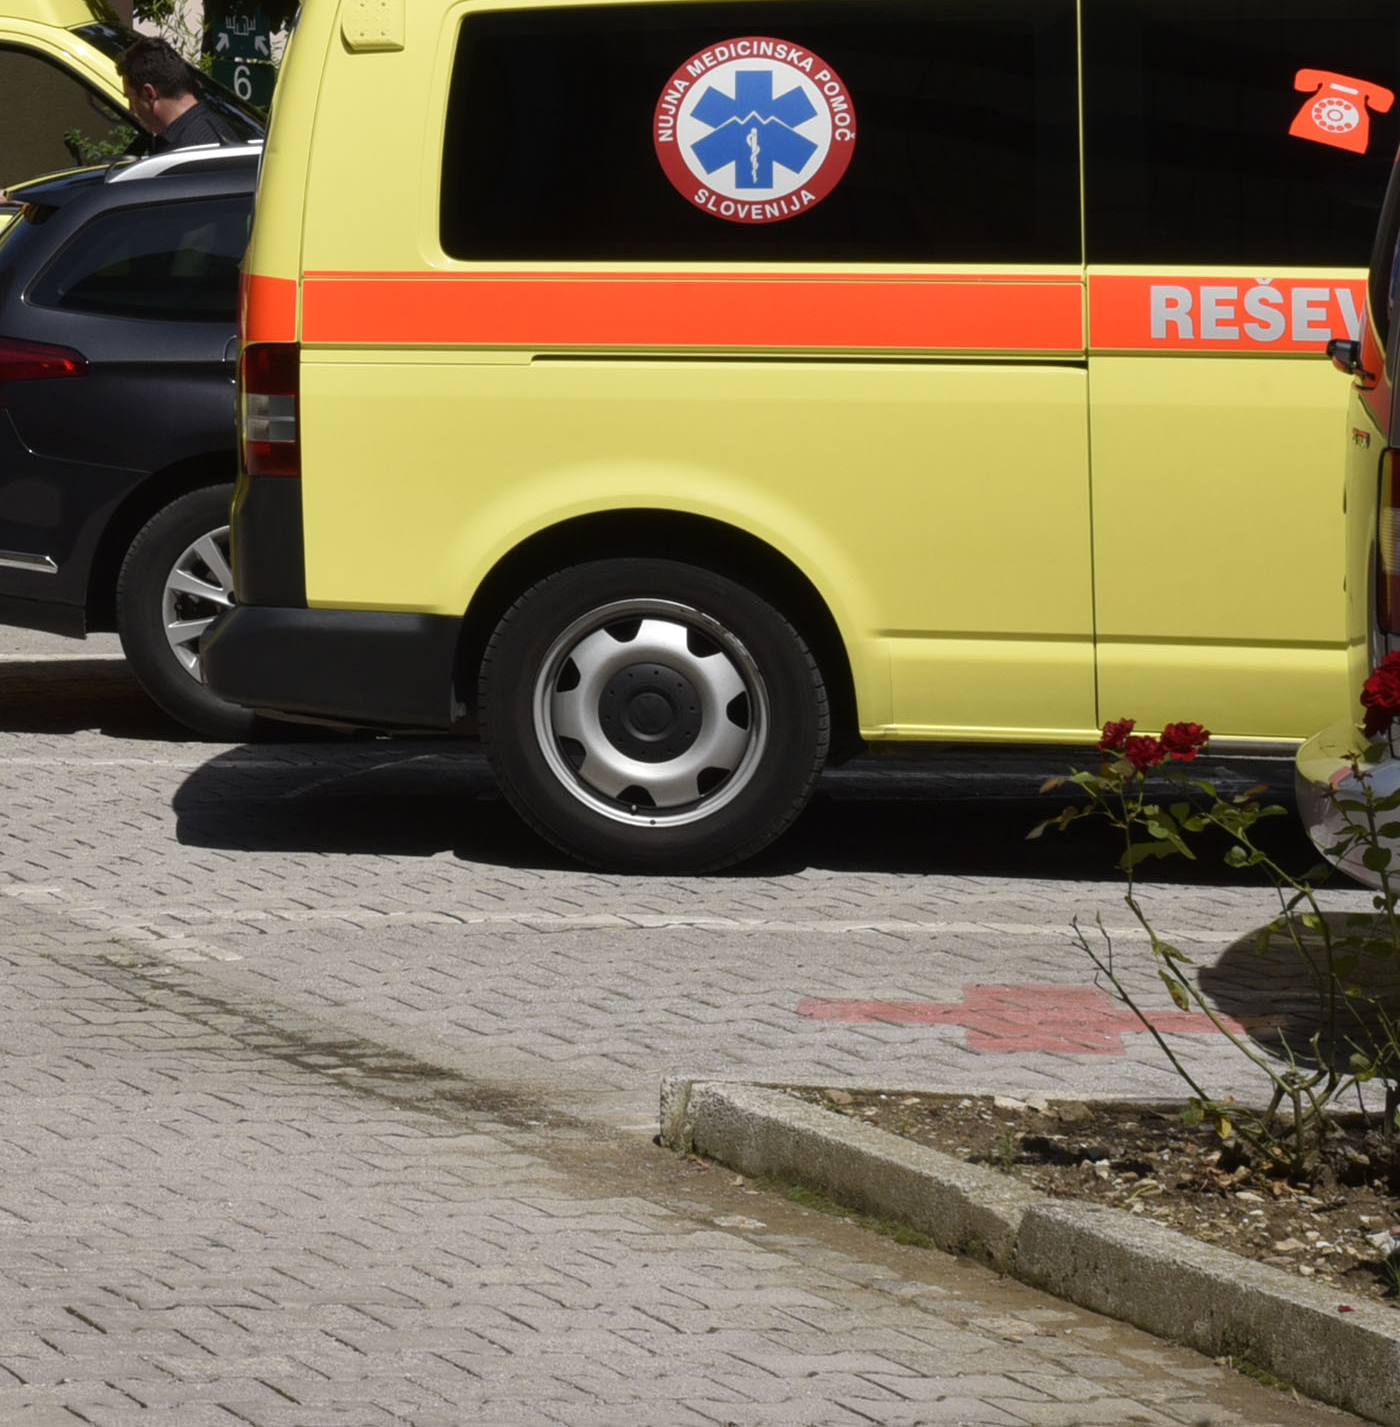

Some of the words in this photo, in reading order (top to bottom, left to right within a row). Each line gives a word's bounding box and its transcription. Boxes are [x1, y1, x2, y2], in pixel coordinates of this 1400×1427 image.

[233, 64, 253, 101] 6
[658, 78, 690, 142] NUJNA
[686, 40, 814, 79] MEDICINSKA
[815, 69, 856, 142] POMOČ
[694, 188, 816, 220] SLOVENIJA
